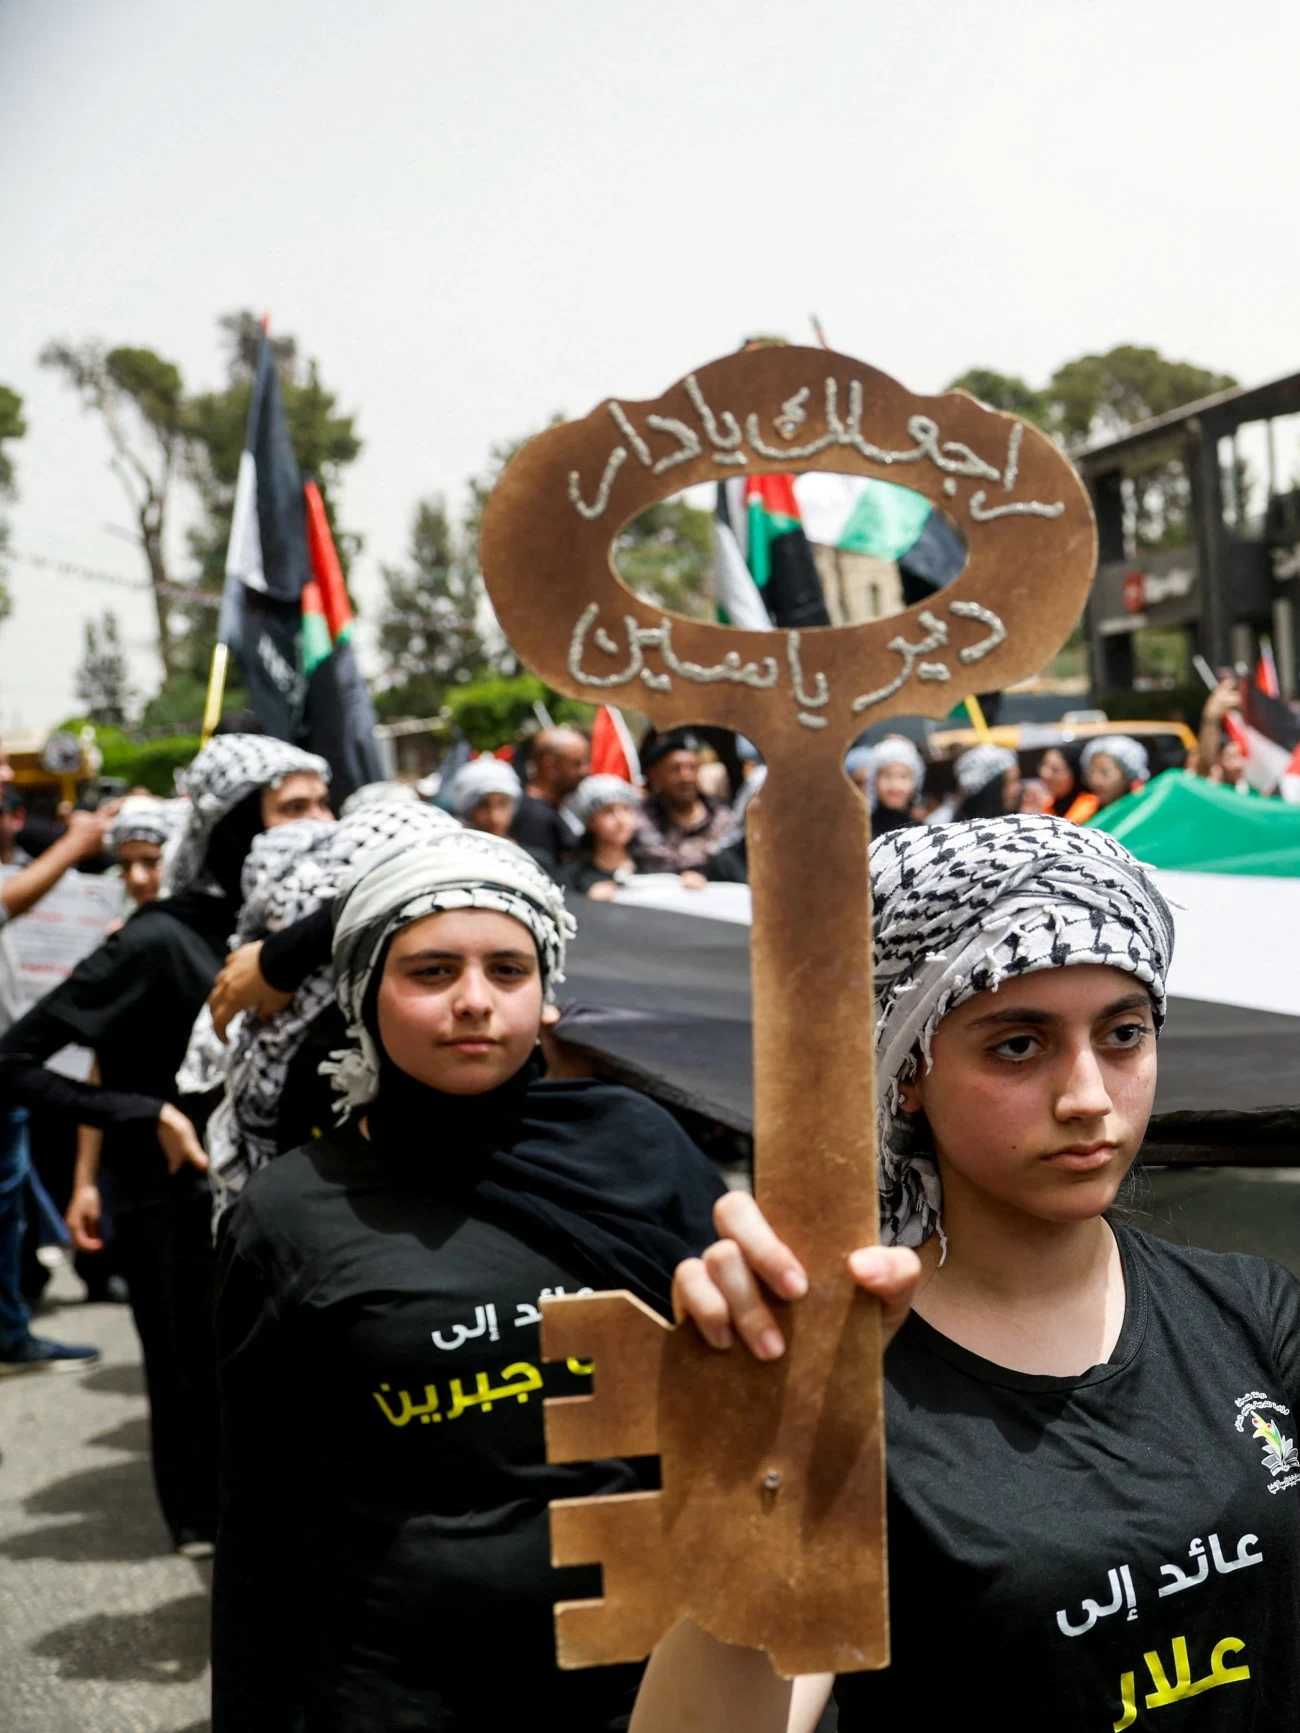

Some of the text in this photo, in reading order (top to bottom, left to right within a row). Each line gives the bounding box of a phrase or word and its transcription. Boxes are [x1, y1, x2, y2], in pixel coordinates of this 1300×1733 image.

[566, 400, 703, 520] دار
[567, 600, 1006, 728] دير ياسين
[431, 1302, 500, 1350] إلى
[372, 1361, 544, 1427] جبرين
[1056, 1533, 1264, 1637] عائد إلى
[1112, 1636, 1251, 1733] علار
